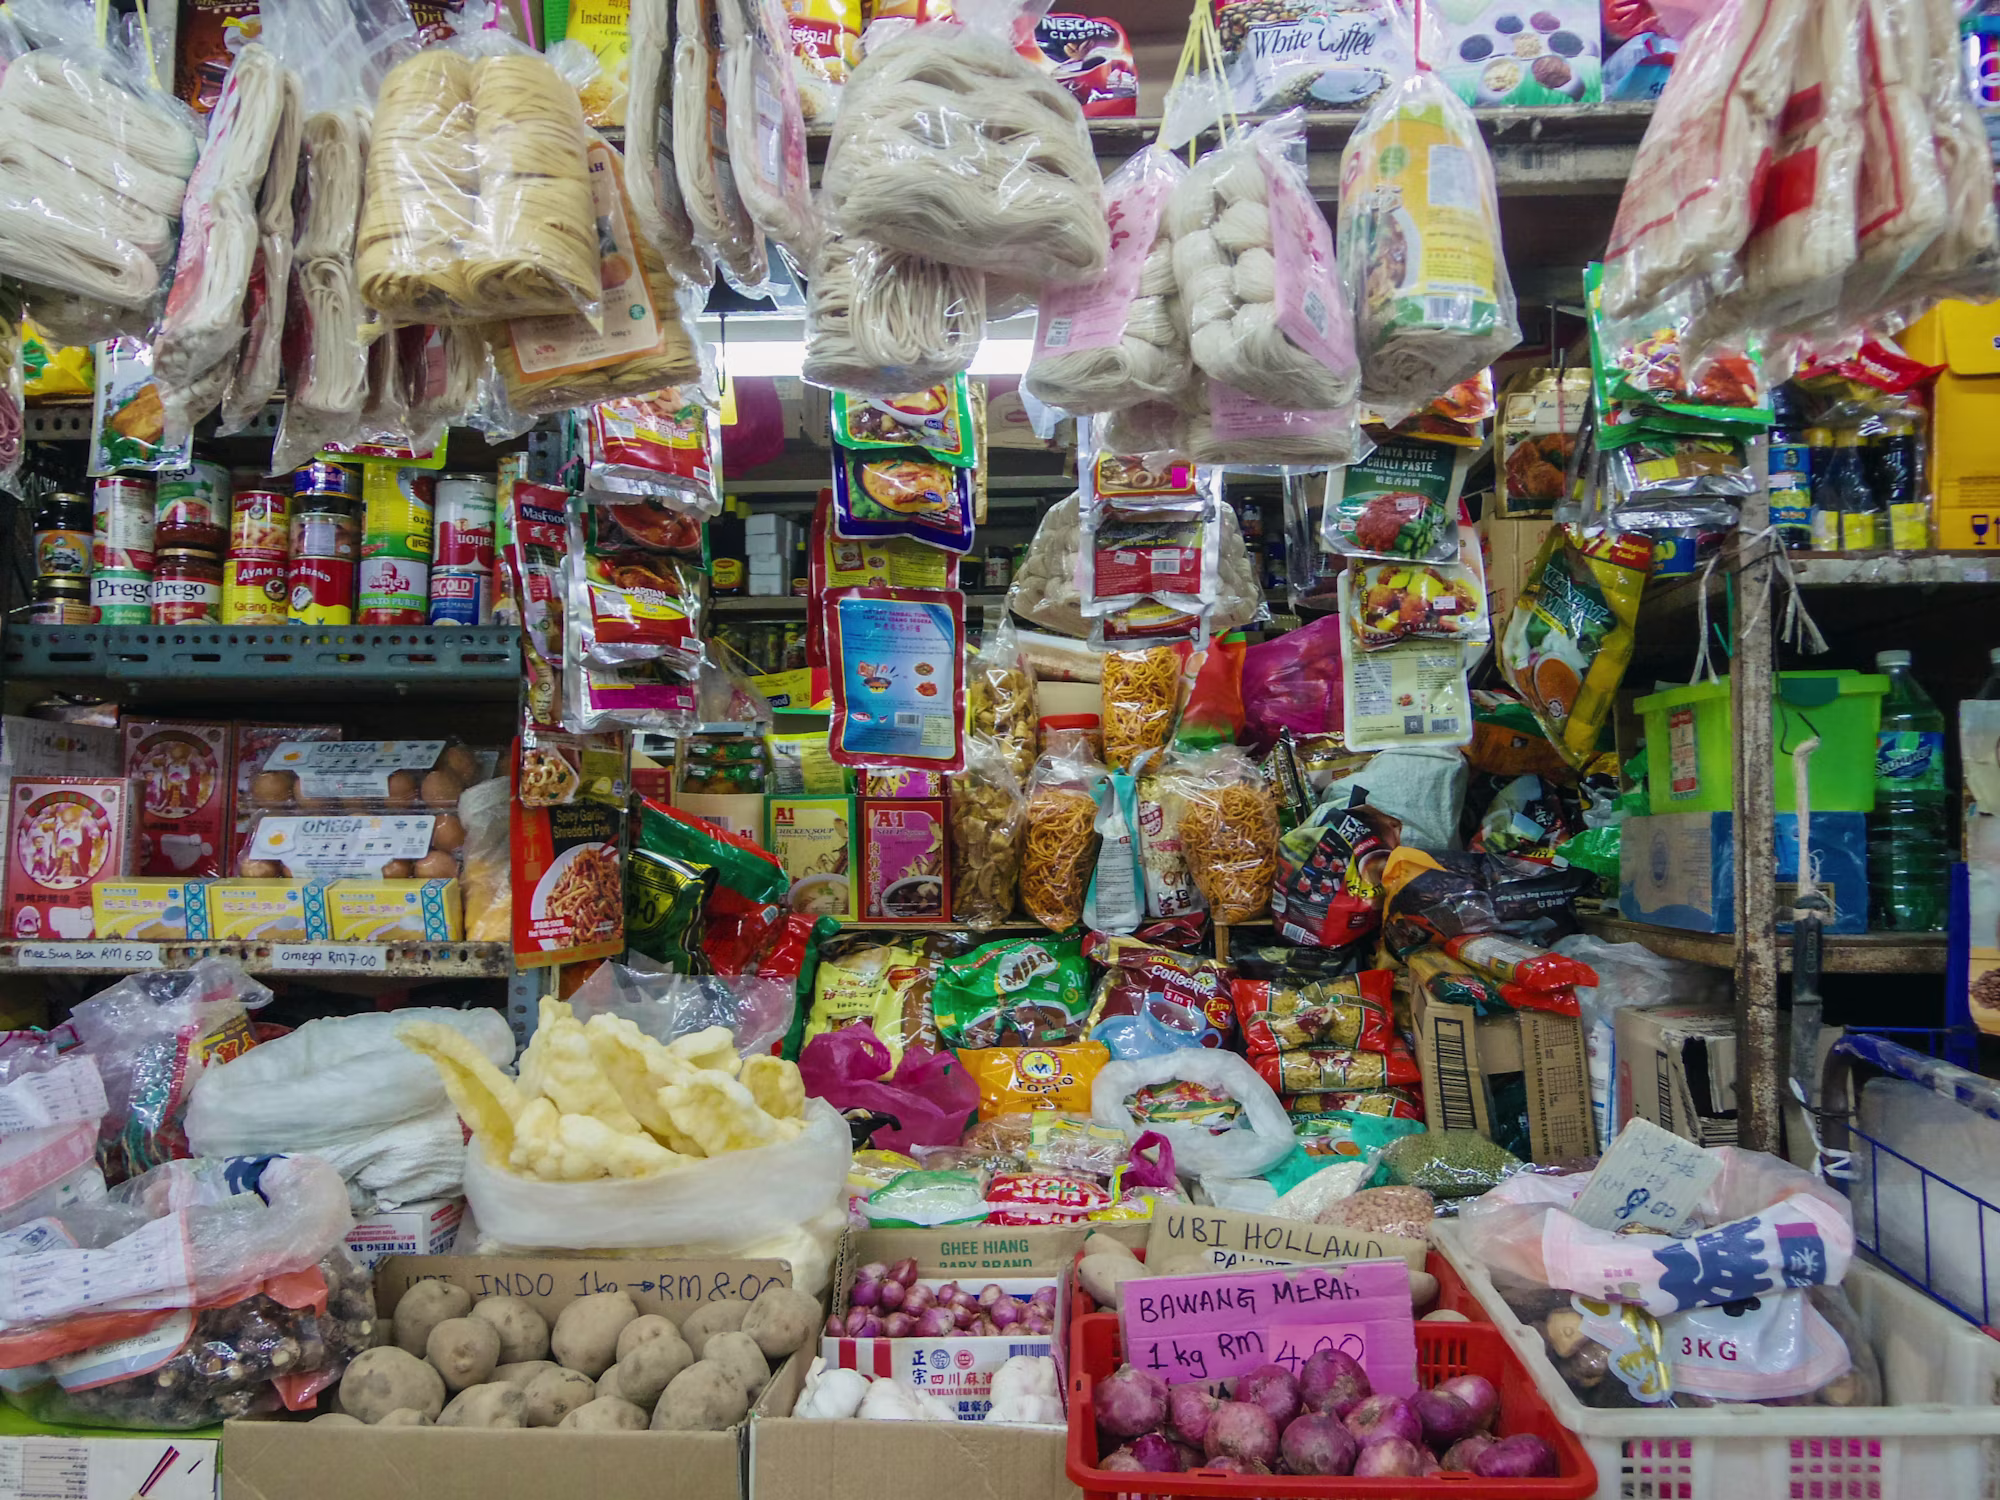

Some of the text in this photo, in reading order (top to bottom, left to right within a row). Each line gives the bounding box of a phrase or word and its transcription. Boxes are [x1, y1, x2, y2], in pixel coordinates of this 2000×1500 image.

[580, 9, 621, 25] Instant
[1049, 29, 1109, 40] CLASSIC
[1253, 22, 1376, 61] White Coffee
[1406, 449, 1437, 460] STYLE
[1367, 457, 1433, 472] CHILLI PASTE
[160, 464, 195, 481] rego
[239, 567, 273, 581] AYAM
[155, 582, 205, 601] Prego
[234, 602, 267, 615] Kacang
[317, 743, 377, 754] OMEGA
[556, 810, 578, 825] Spicy
[775, 807, 794, 821] A1
[877, 811, 905, 828] A1
[302, 819, 363, 833] OMEGA
[553, 824, 611, 839] Shredded Pork
[811, 827, 835, 835] SOUP
[50, 949, 73, 961] Sua
[76, 949, 96, 960] Box
[125, 950, 153, 962] 6.50
[1002, 950, 1053, 987] MILO
[1165, 991, 1172, 999] 3
[1534, 1035, 1542, 1066] PALLETS
[1538, 1091, 1547, 1122] STACKED
[1167, 1215, 1228, 1248] UBI
[1245, 1223, 1384, 1259] HOLLAND
[351, 1243, 363, 1252] SD
[397, 1242, 416, 1250] LUN
[941, 1239, 1029, 1256] GHEE HIANG
[475, 1272, 554, 1298] INDO
[658, 1274, 702, 1302] RM
[1140, 1287, 1257, 1323] BAWANG
[1218, 1331, 1265, 1360] RM
[912, 1350, 928, 1385] 正宗
